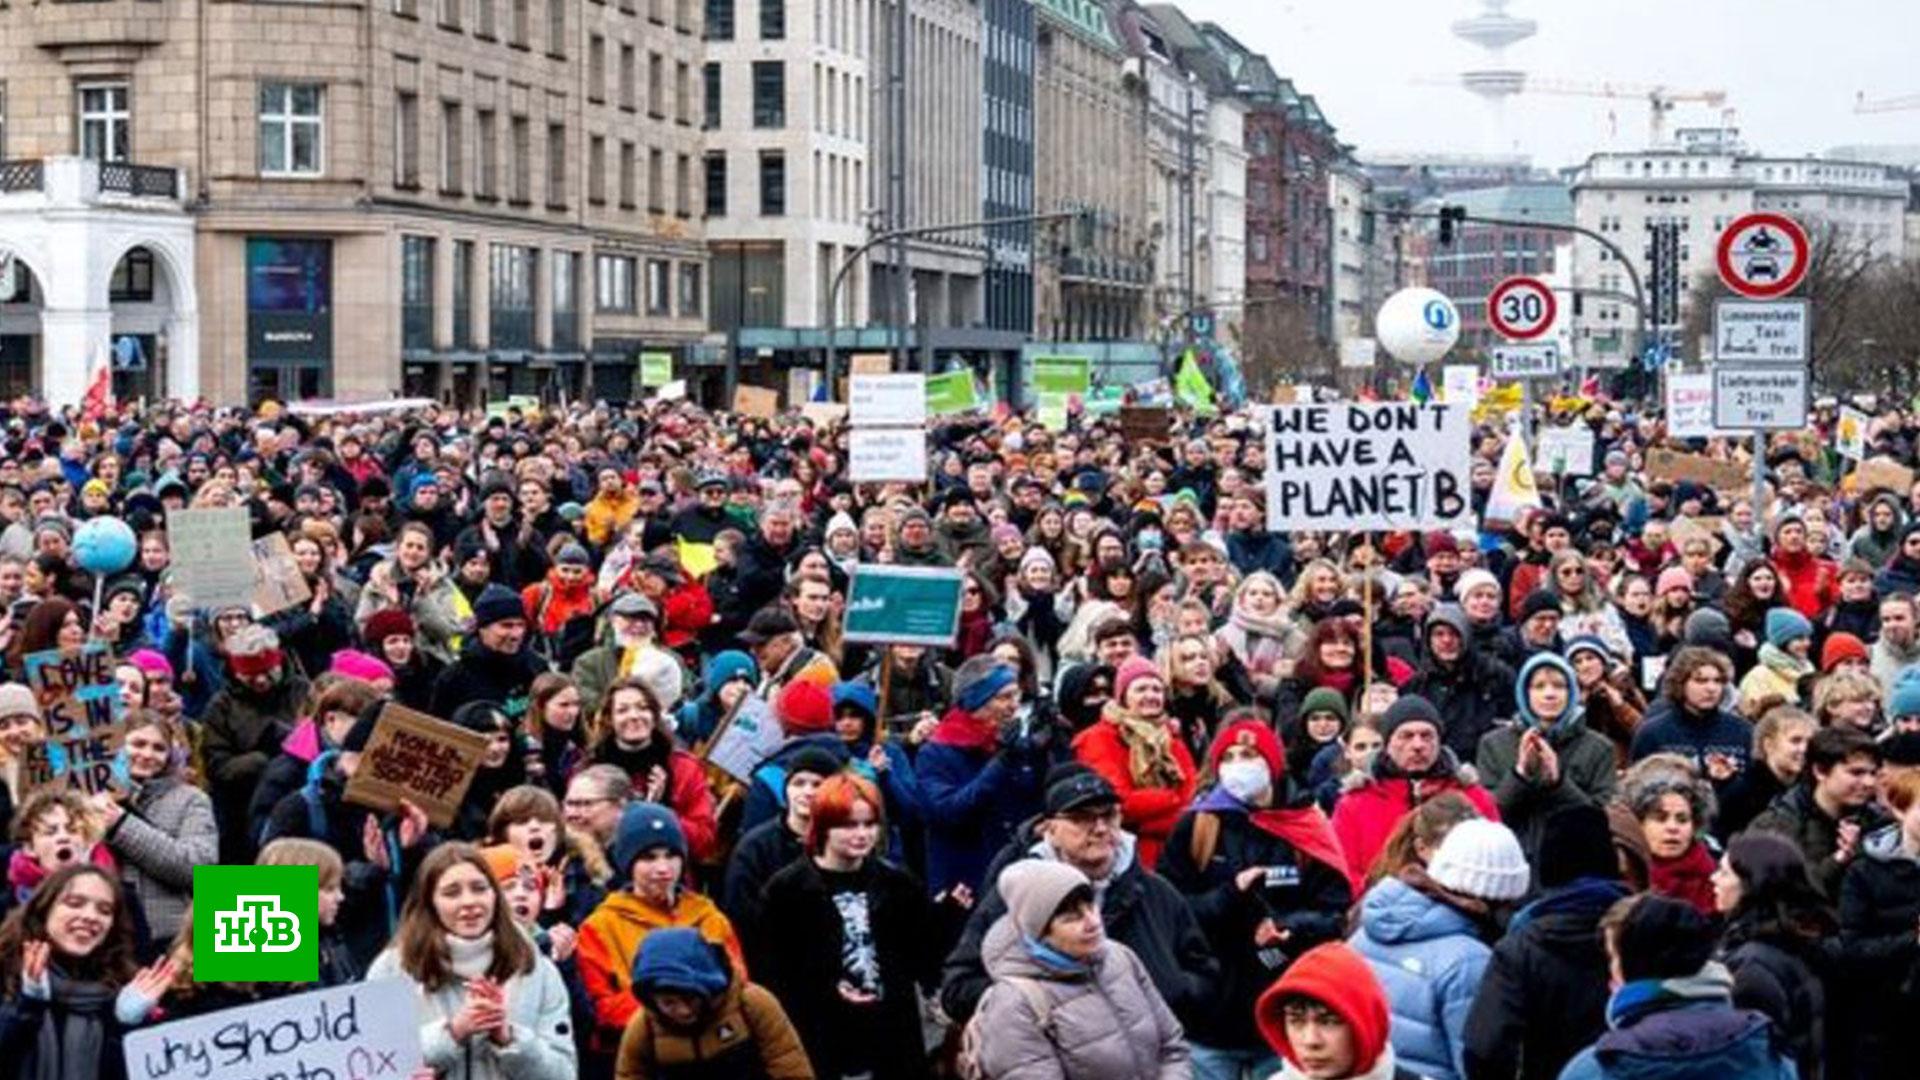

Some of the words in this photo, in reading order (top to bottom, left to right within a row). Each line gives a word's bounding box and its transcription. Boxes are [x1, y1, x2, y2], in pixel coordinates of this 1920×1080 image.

[1503, 294, 1542, 323] 30
[1756, 325, 1786, 338] Taxi
[1273, 408, 1328, 433] WE
[1348, 403, 1449, 433] DON'T
[1276, 438, 1376, 471] HAVE
[1388, 438, 1416, 466] A
[1281, 470, 1428, 518] PLANET
[1433, 469, 1464, 519] B
[85, 697, 111, 728] IN
[64, 733, 115, 765] THE
[66, 763, 116, 796] AIR
